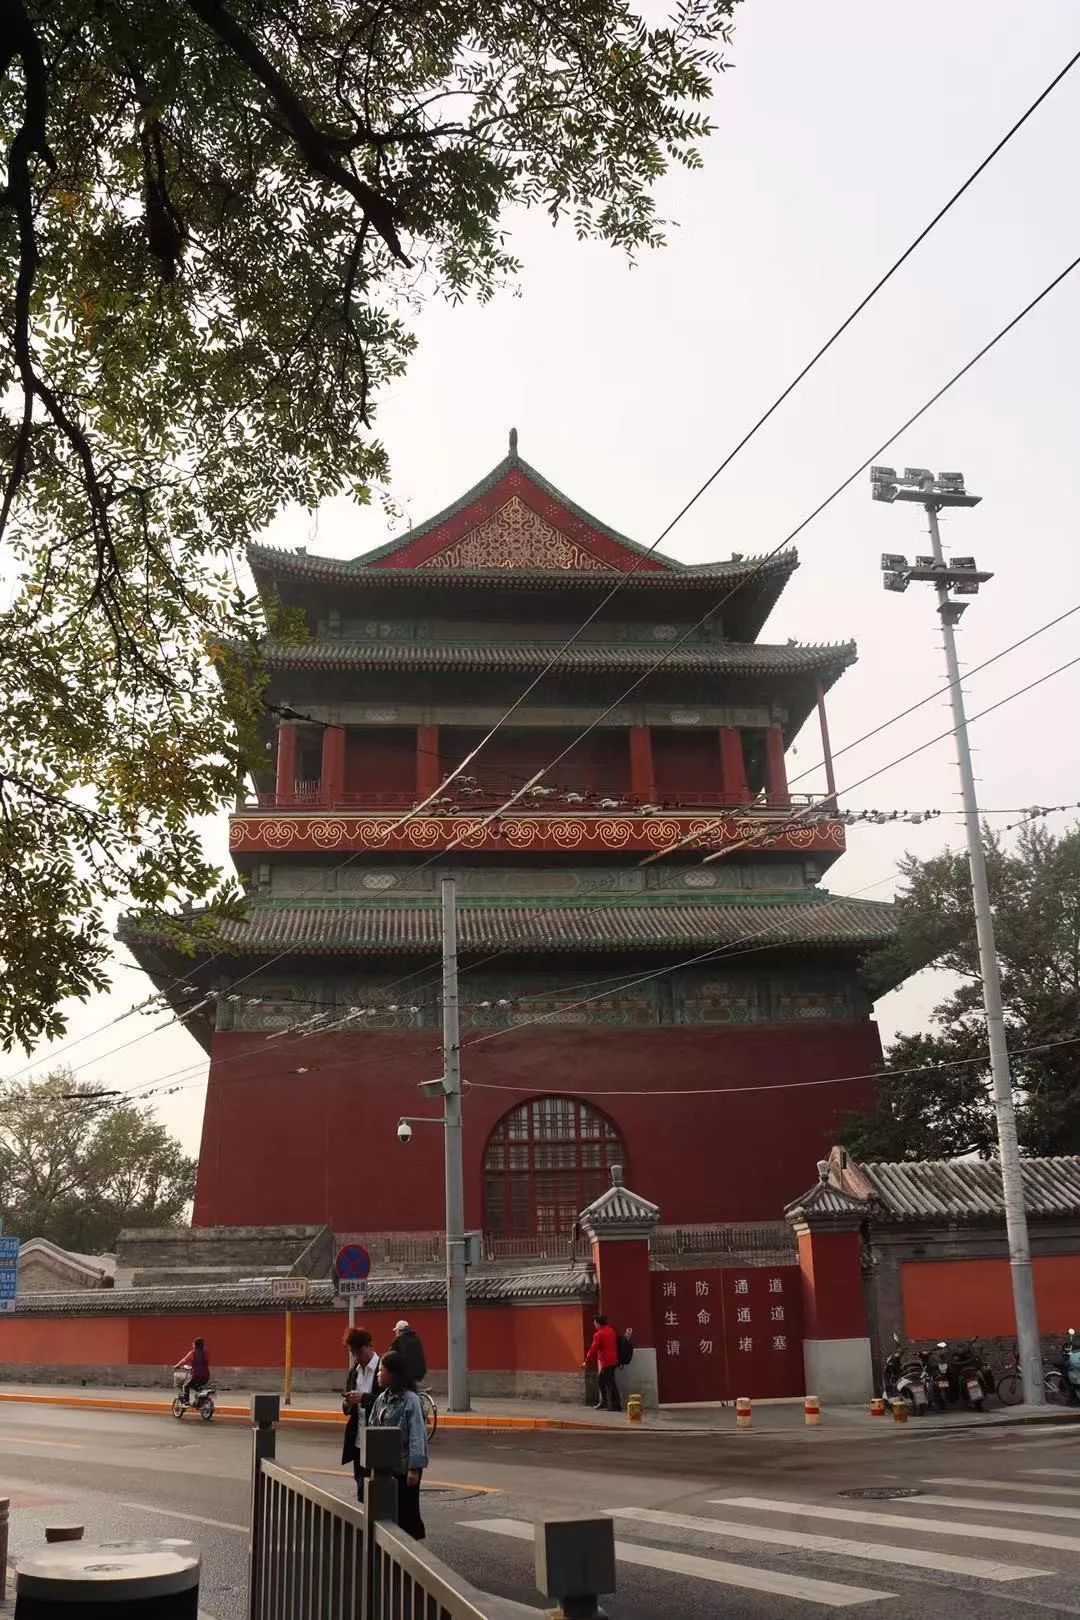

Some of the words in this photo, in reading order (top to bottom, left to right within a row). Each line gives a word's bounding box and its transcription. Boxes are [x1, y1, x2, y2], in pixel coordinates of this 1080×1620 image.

[663, 1279, 783, 1296] 消防通道
[665, 1306, 784, 1325] 生命通道
[666, 1336, 786, 1355] 请勿堵塞
